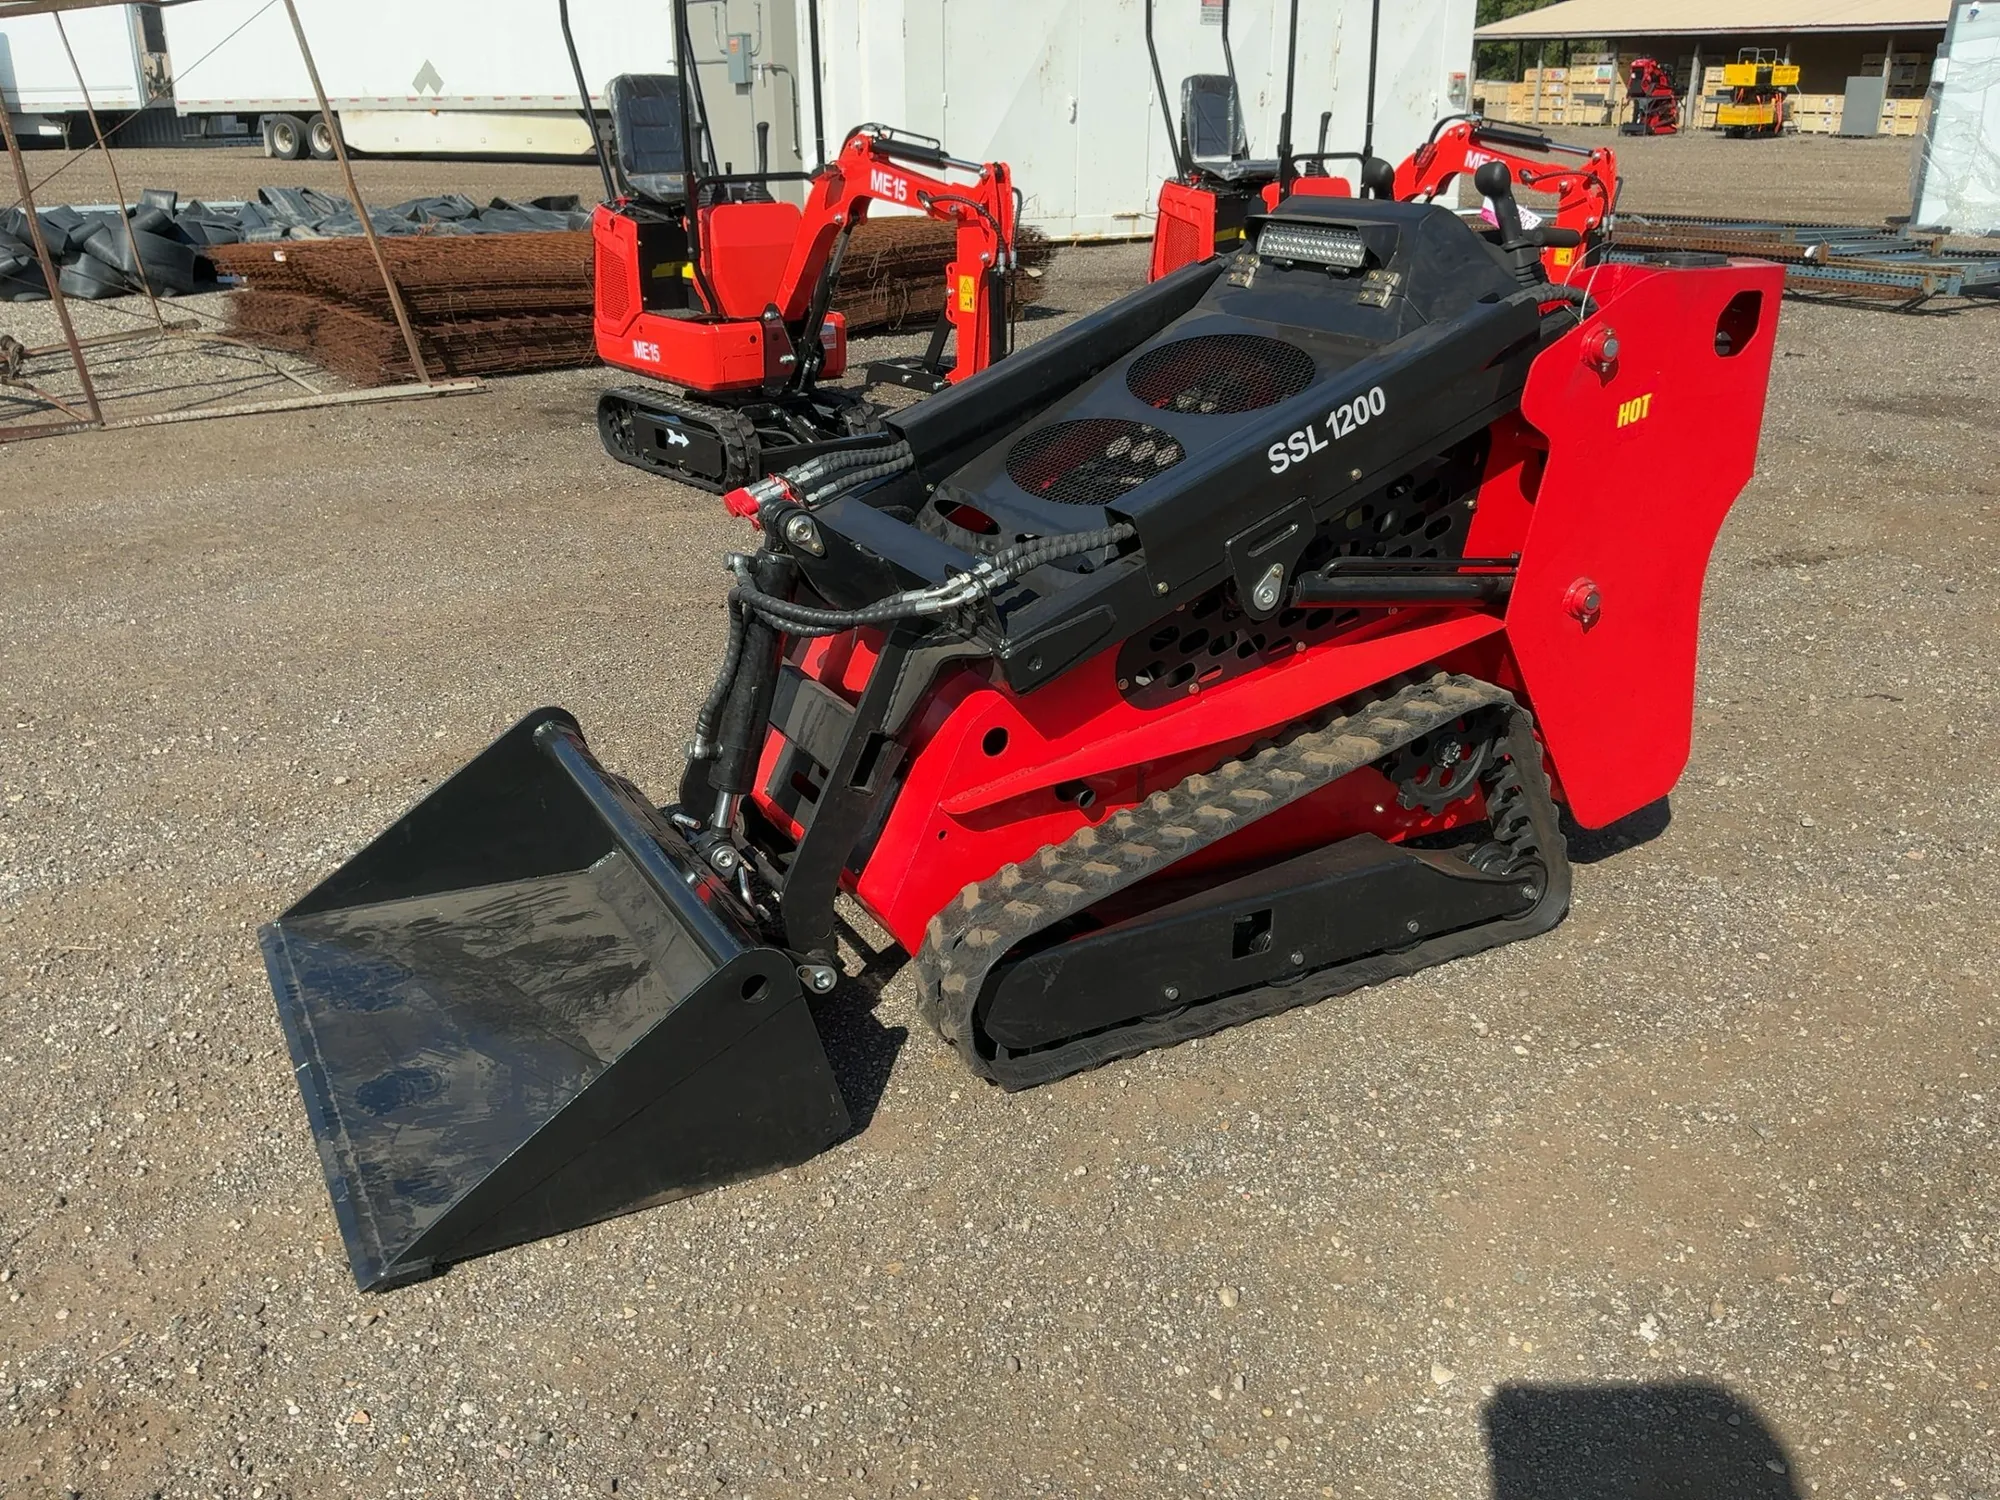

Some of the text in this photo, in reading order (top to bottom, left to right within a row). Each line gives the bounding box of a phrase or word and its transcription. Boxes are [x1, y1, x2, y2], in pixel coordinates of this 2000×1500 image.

[1464, 150, 1507, 171] ME
[871, 168, 908, 202] ME15
[632, 339, 661, 363] ME15
[1617, 392, 1653, 428] HOT
[1267, 386, 1386, 474] SSL 1200
